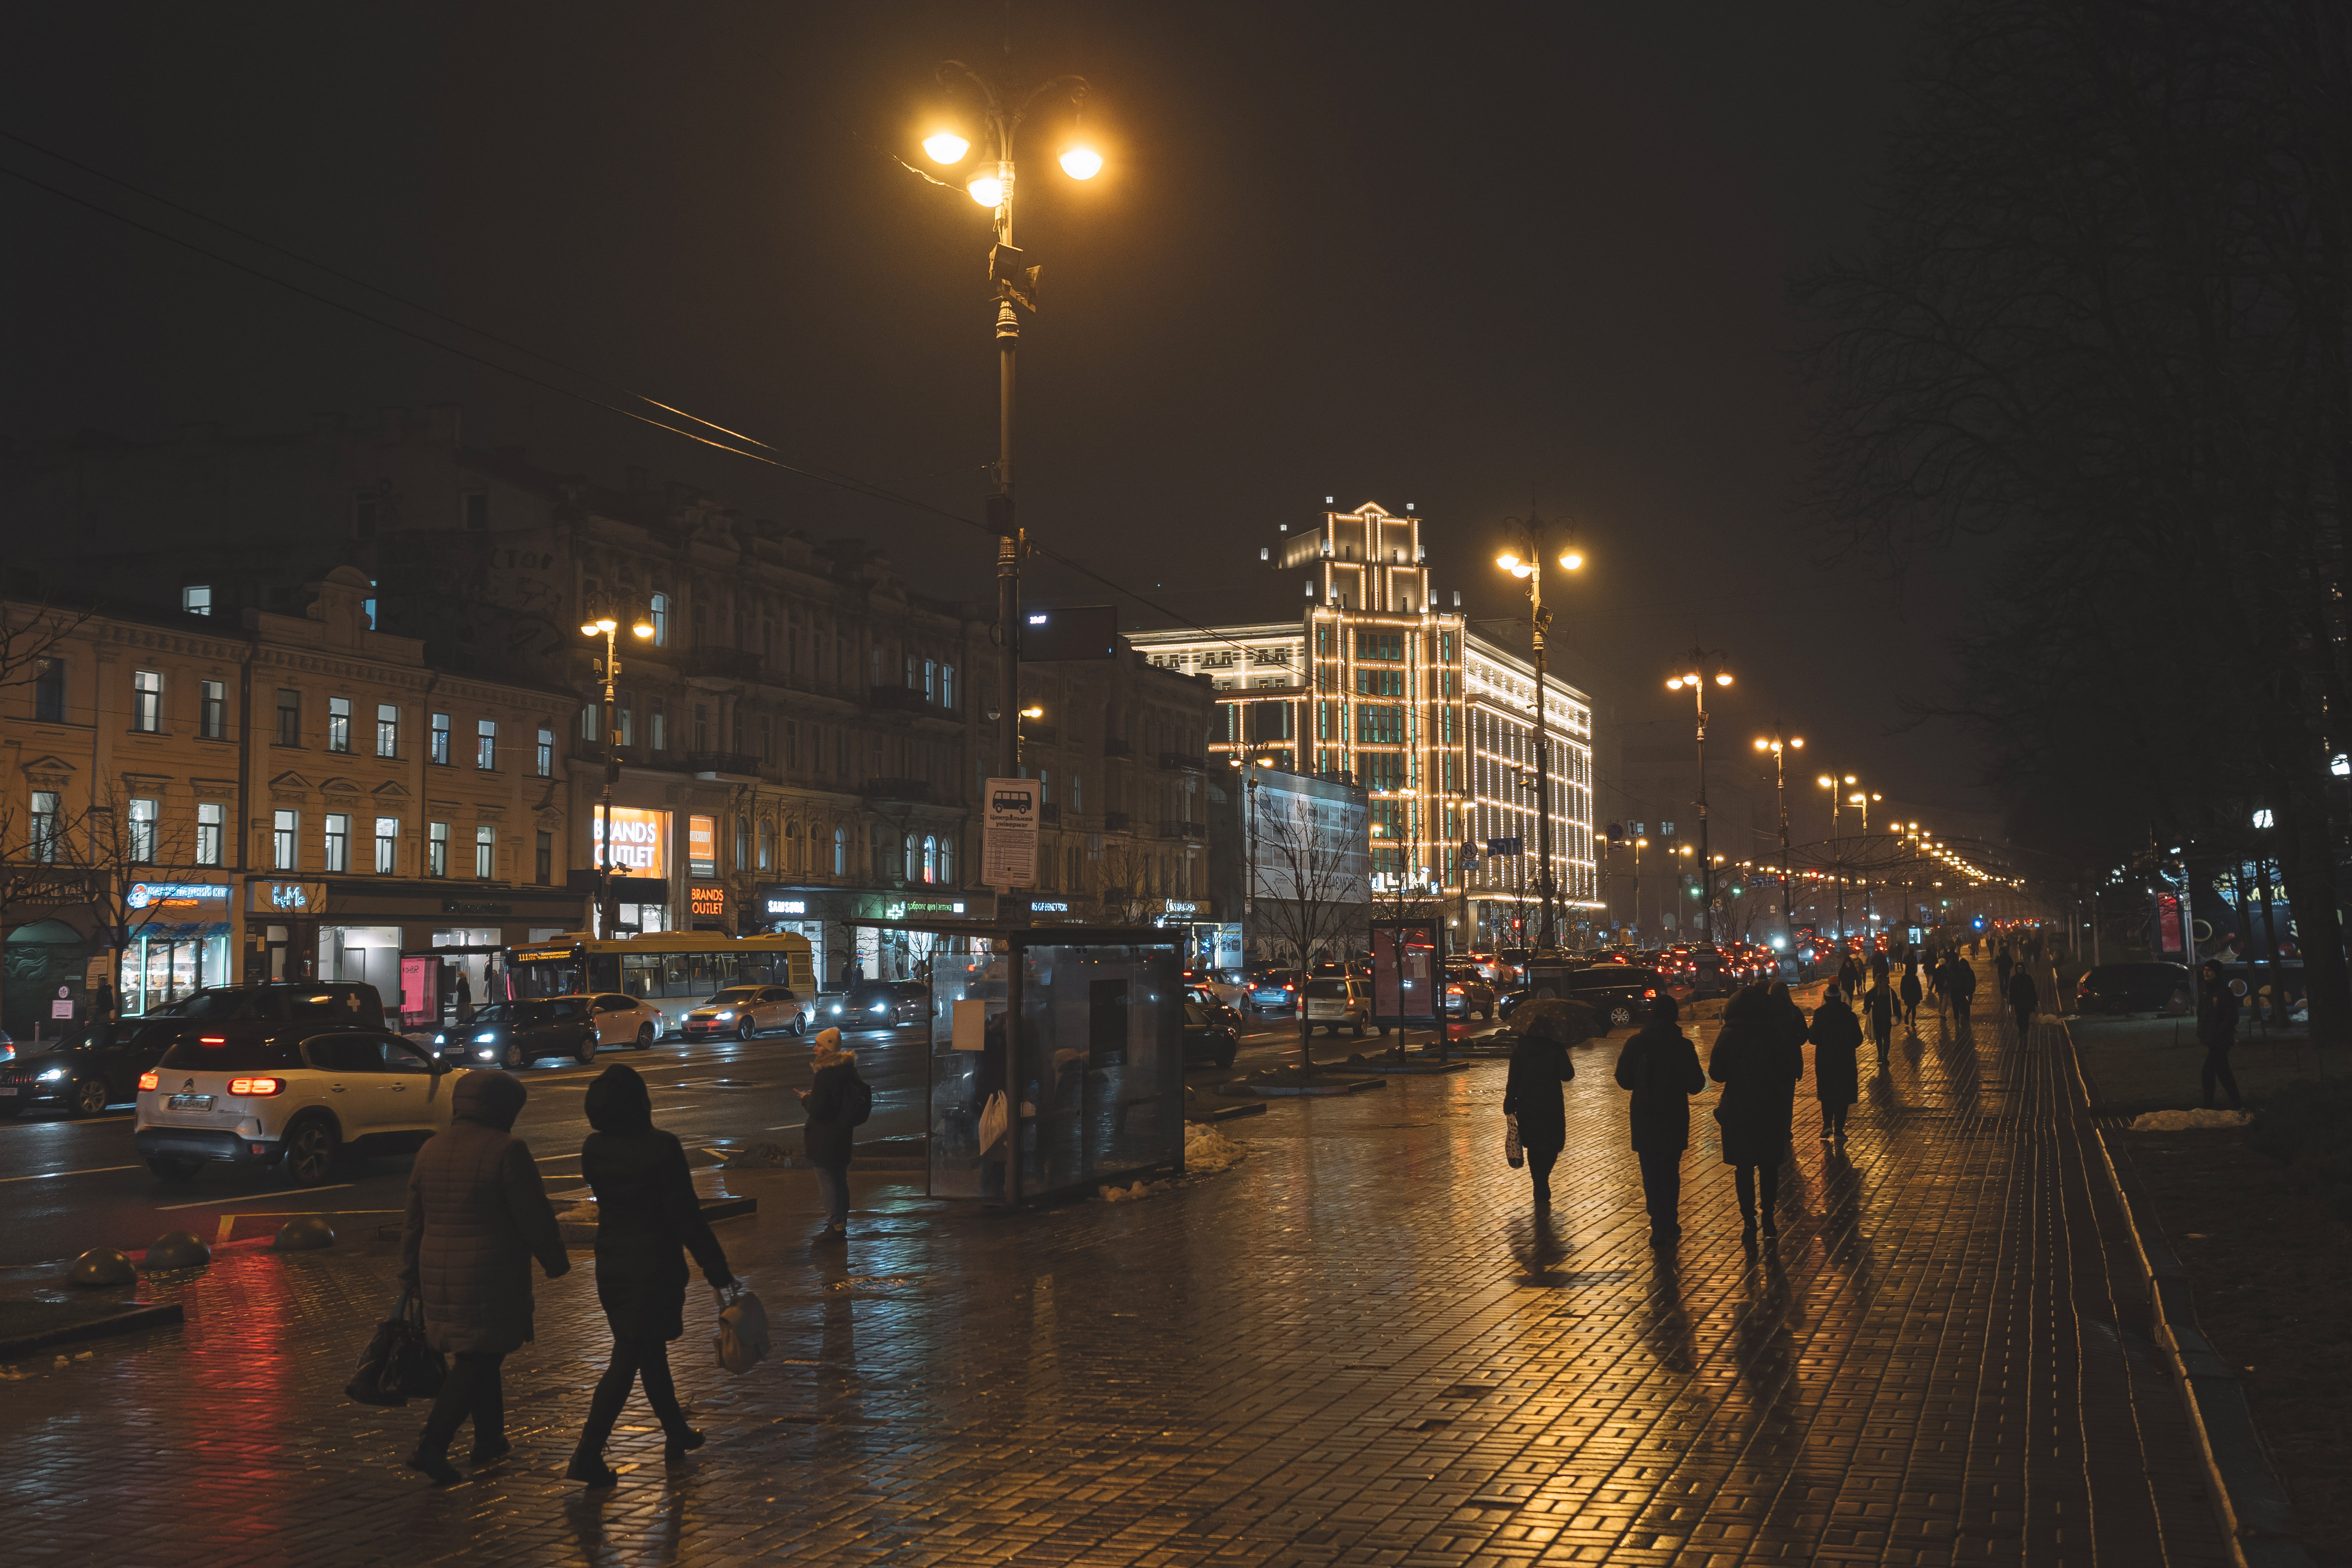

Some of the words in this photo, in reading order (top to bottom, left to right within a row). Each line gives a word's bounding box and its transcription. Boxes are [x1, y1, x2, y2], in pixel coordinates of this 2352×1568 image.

[594, 819, 656, 844] BANDS
[212, 887, 227, 897] КІТ
[692, 888, 724, 902] BRANDS
[692, 902, 723, 915] OUTLET
[768, 900, 805, 913] SAMSUNG
